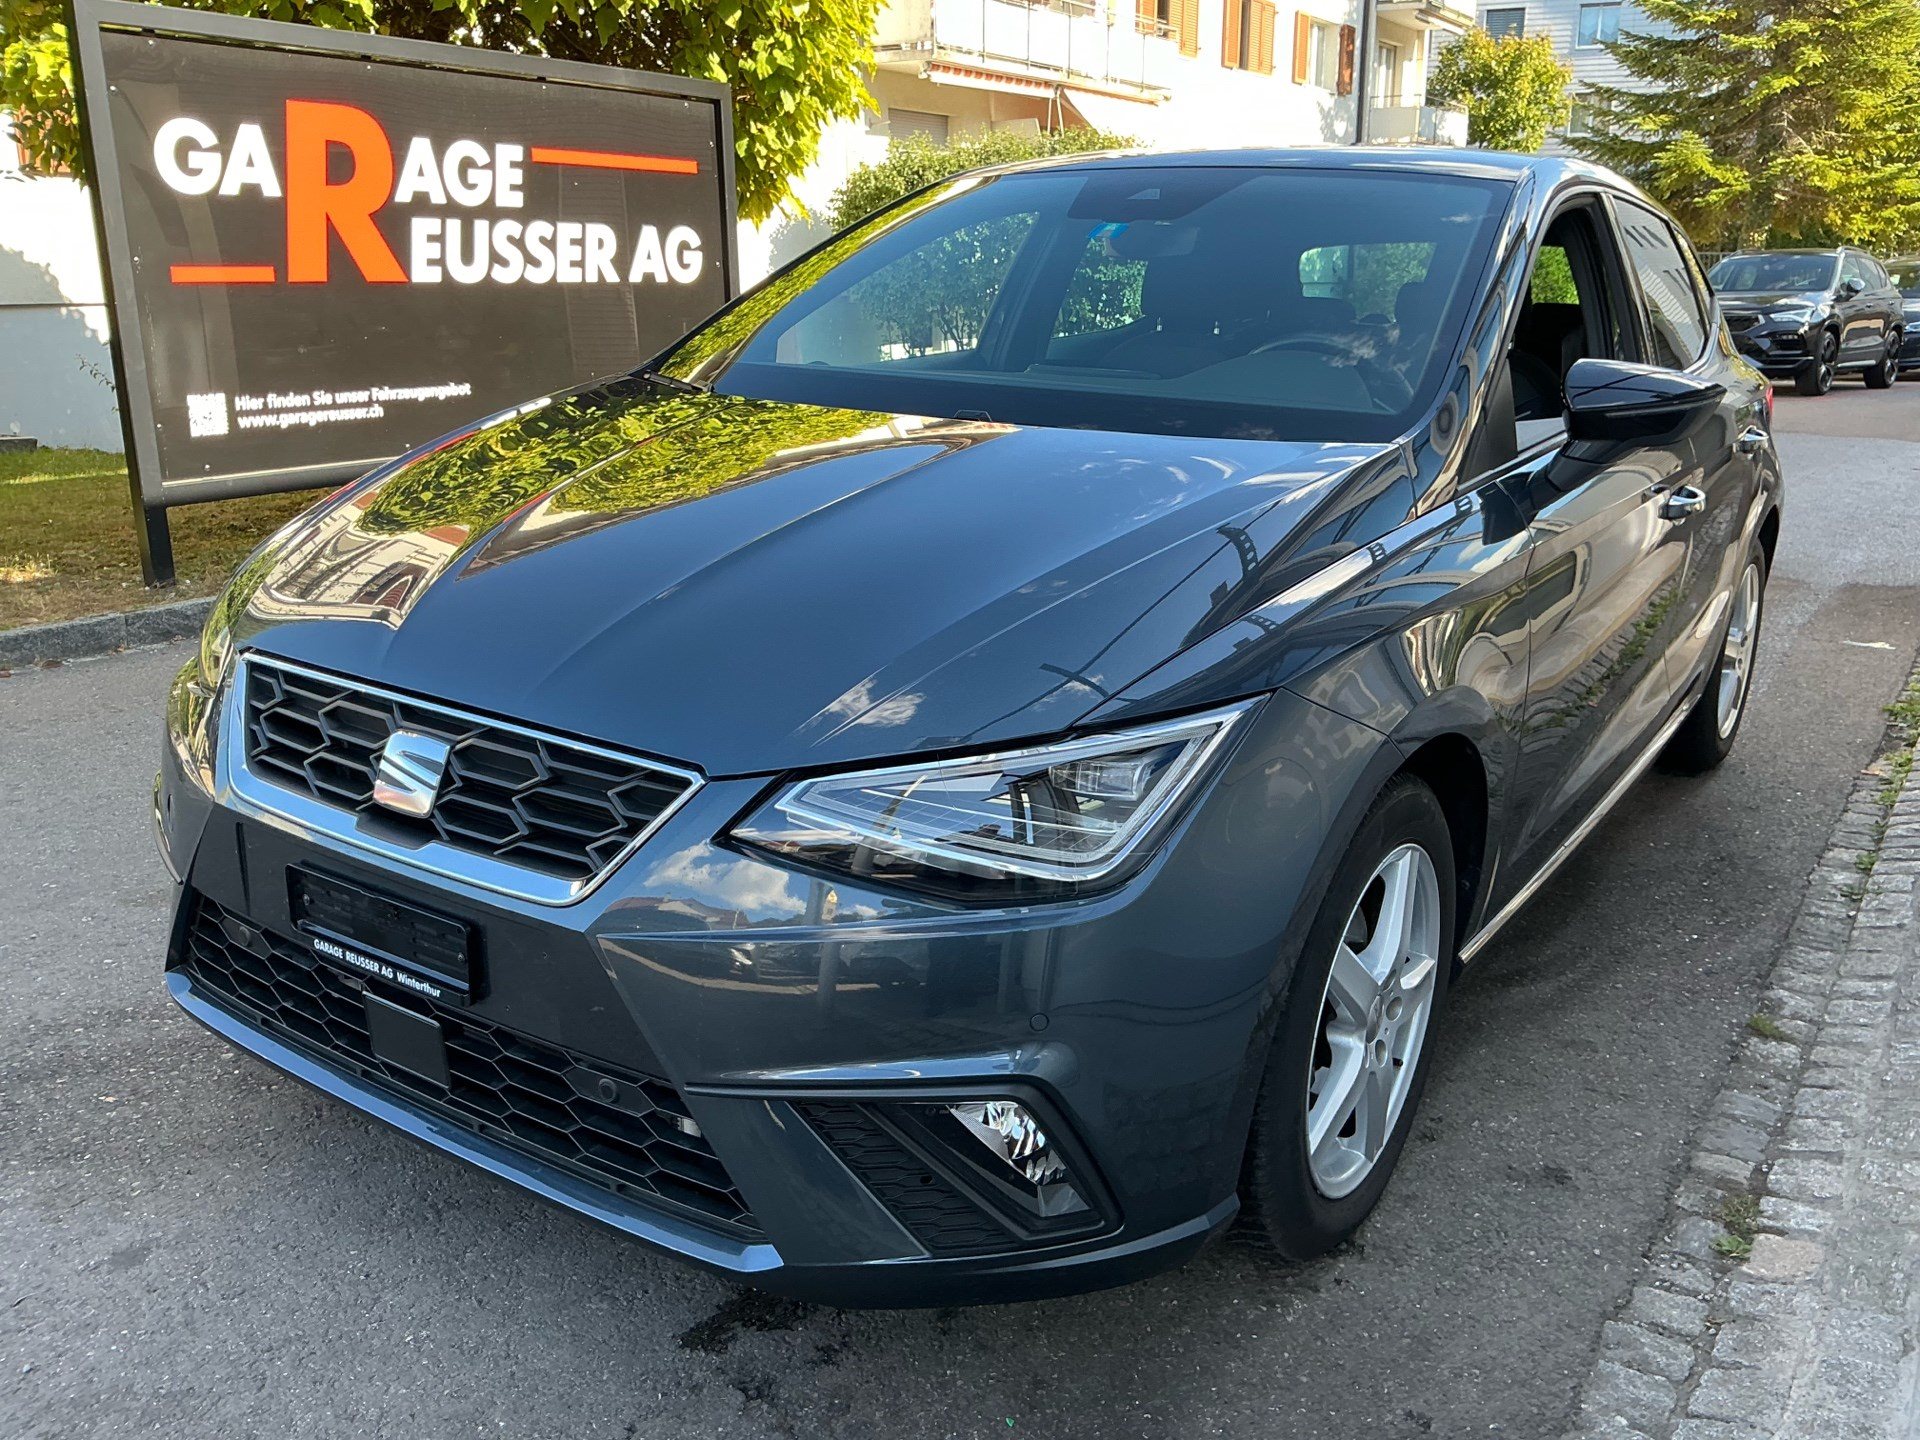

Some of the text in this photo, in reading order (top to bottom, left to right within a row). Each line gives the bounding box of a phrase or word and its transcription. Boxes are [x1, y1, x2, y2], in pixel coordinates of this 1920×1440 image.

[153, 99, 525, 284] GARAGE
[629, 225, 703, 285] AG
[234, 394, 265, 411] Hier
[266, 391, 311, 409] finden
[312, 389, 333, 406] Sie
[334, 390, 370, 404] unser
[313, 938, 441, 998] GARAGE REUSSER AG Winterthur
